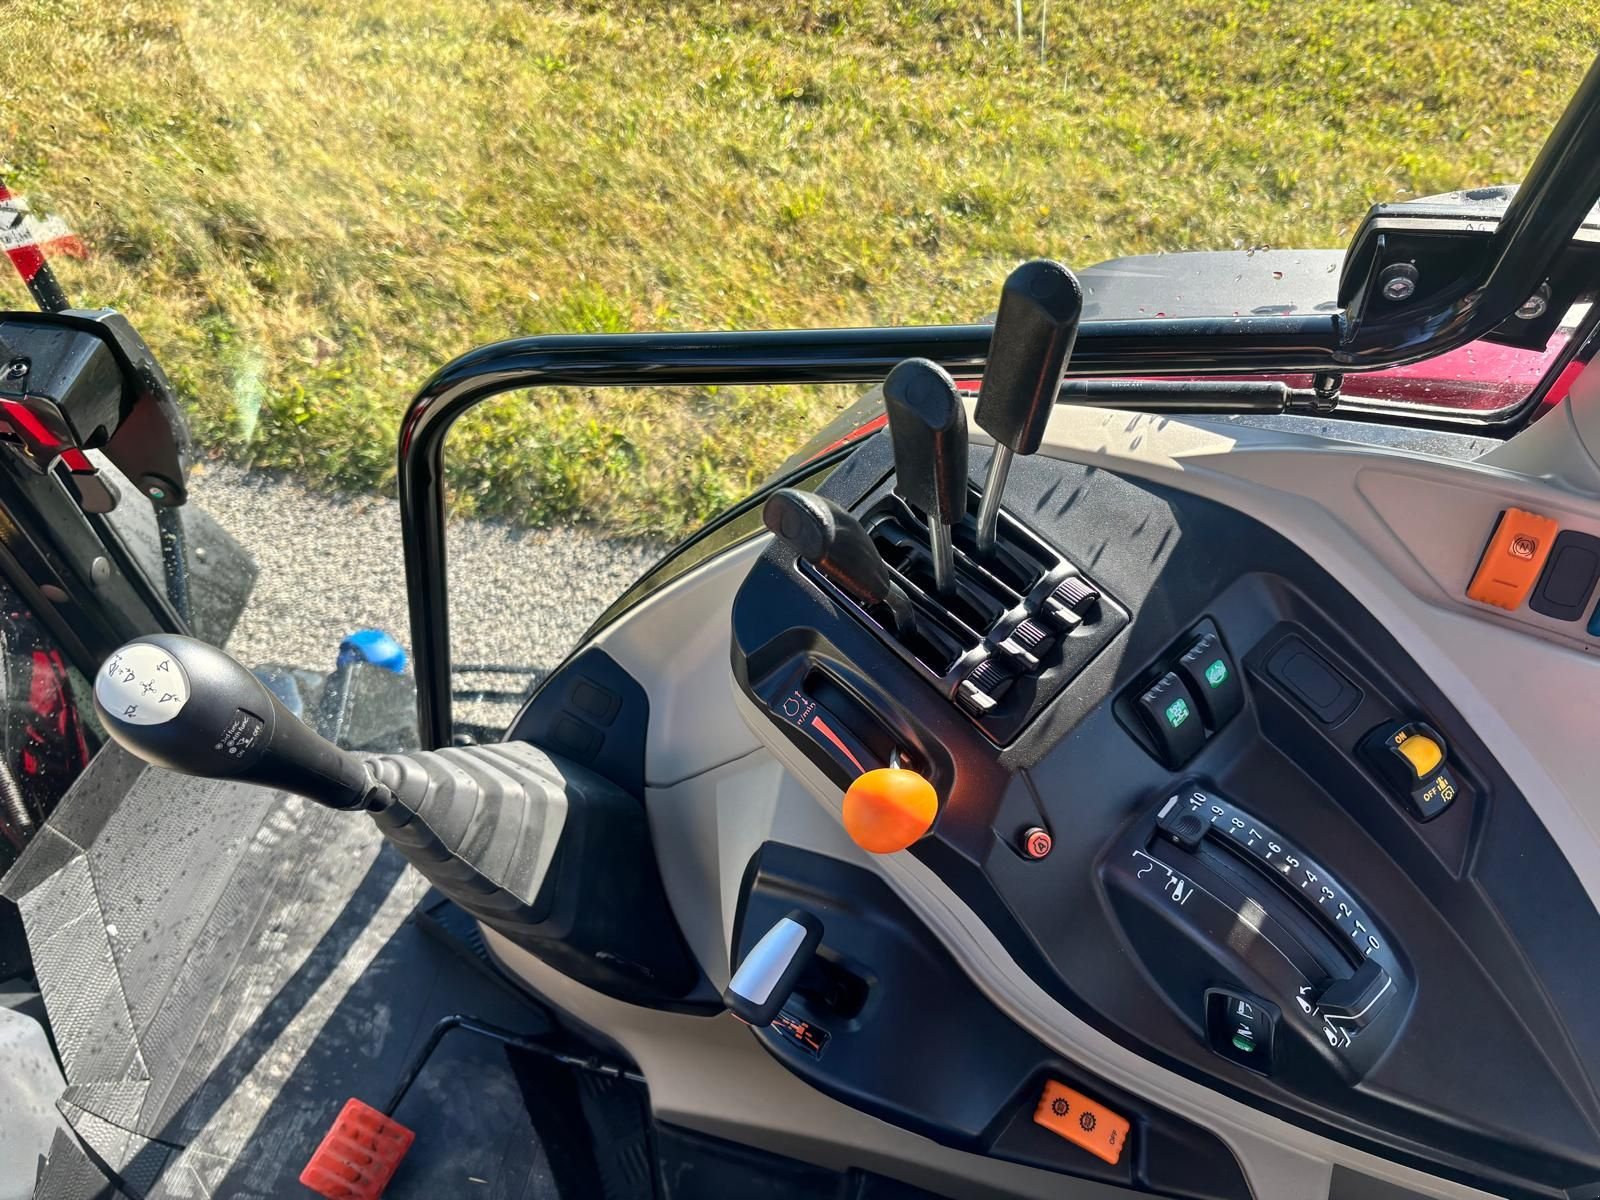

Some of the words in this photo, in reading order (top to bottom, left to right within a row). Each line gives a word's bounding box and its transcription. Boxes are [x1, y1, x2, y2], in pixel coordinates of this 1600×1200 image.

[797, 702, 816, 725] n/min
[1394, 731, 1408, 744] ON
[1423, 786, 1438, 802] OFF
[1190, 792, 1207, 806] 10
[1211, 805, 1225, 816] 9
[1231, 817, 1245, 828] 8
[1249, 828, 1263, 840] 7
[1268, 841, 1281, 853] 6
[1286, 855, 1300, 868] 5
[1305, 869, 1318, 882] 4
[1321, 886, 1335, 899] 3
[1339, 902, 1353, 917] 2
[1355, 919, 1367, 933] 1
[1368, 935, 1380, 949] 0
